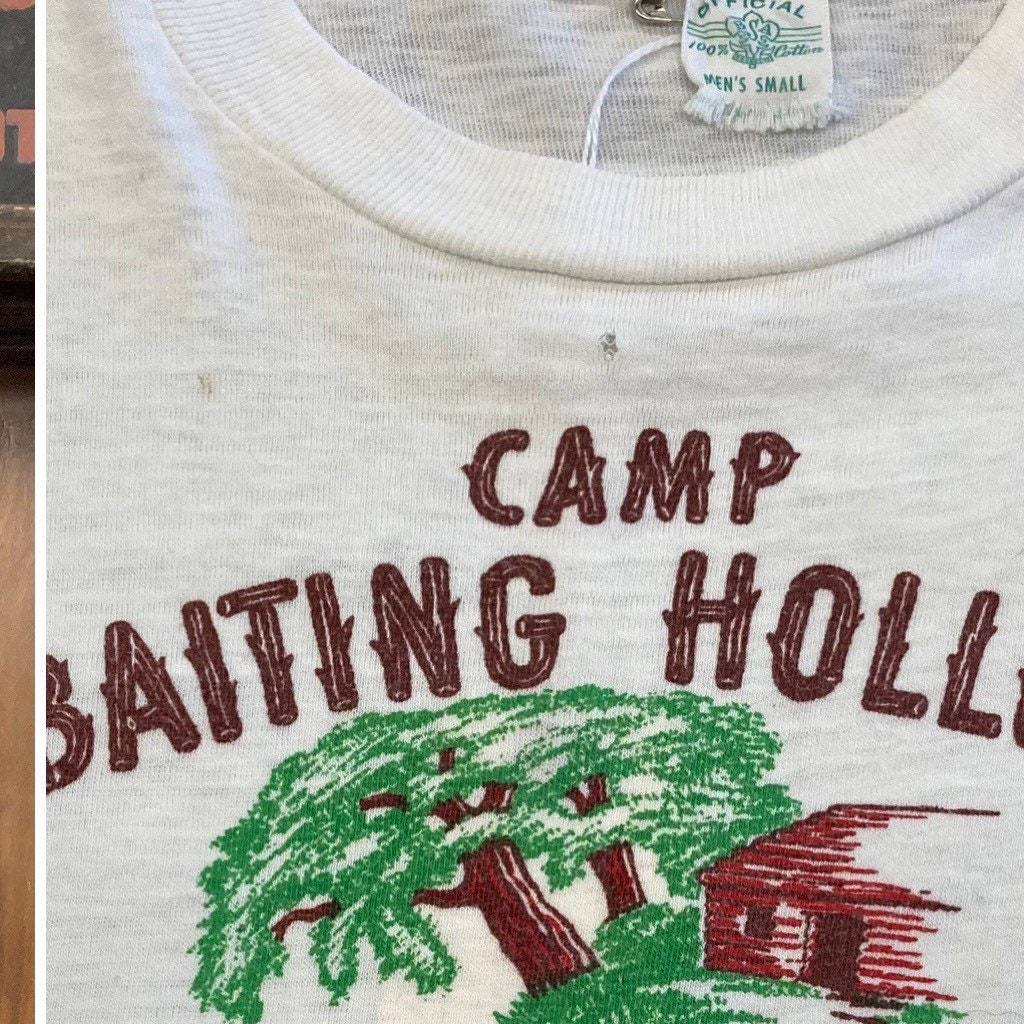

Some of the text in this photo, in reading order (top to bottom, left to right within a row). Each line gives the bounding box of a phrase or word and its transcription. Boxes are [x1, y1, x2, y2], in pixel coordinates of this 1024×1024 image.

[703, 73, 807, 93] MEN'S SMALL
[463, 425, 800, 525] CAMP
[665, 549, 1024, 748] HOLL
